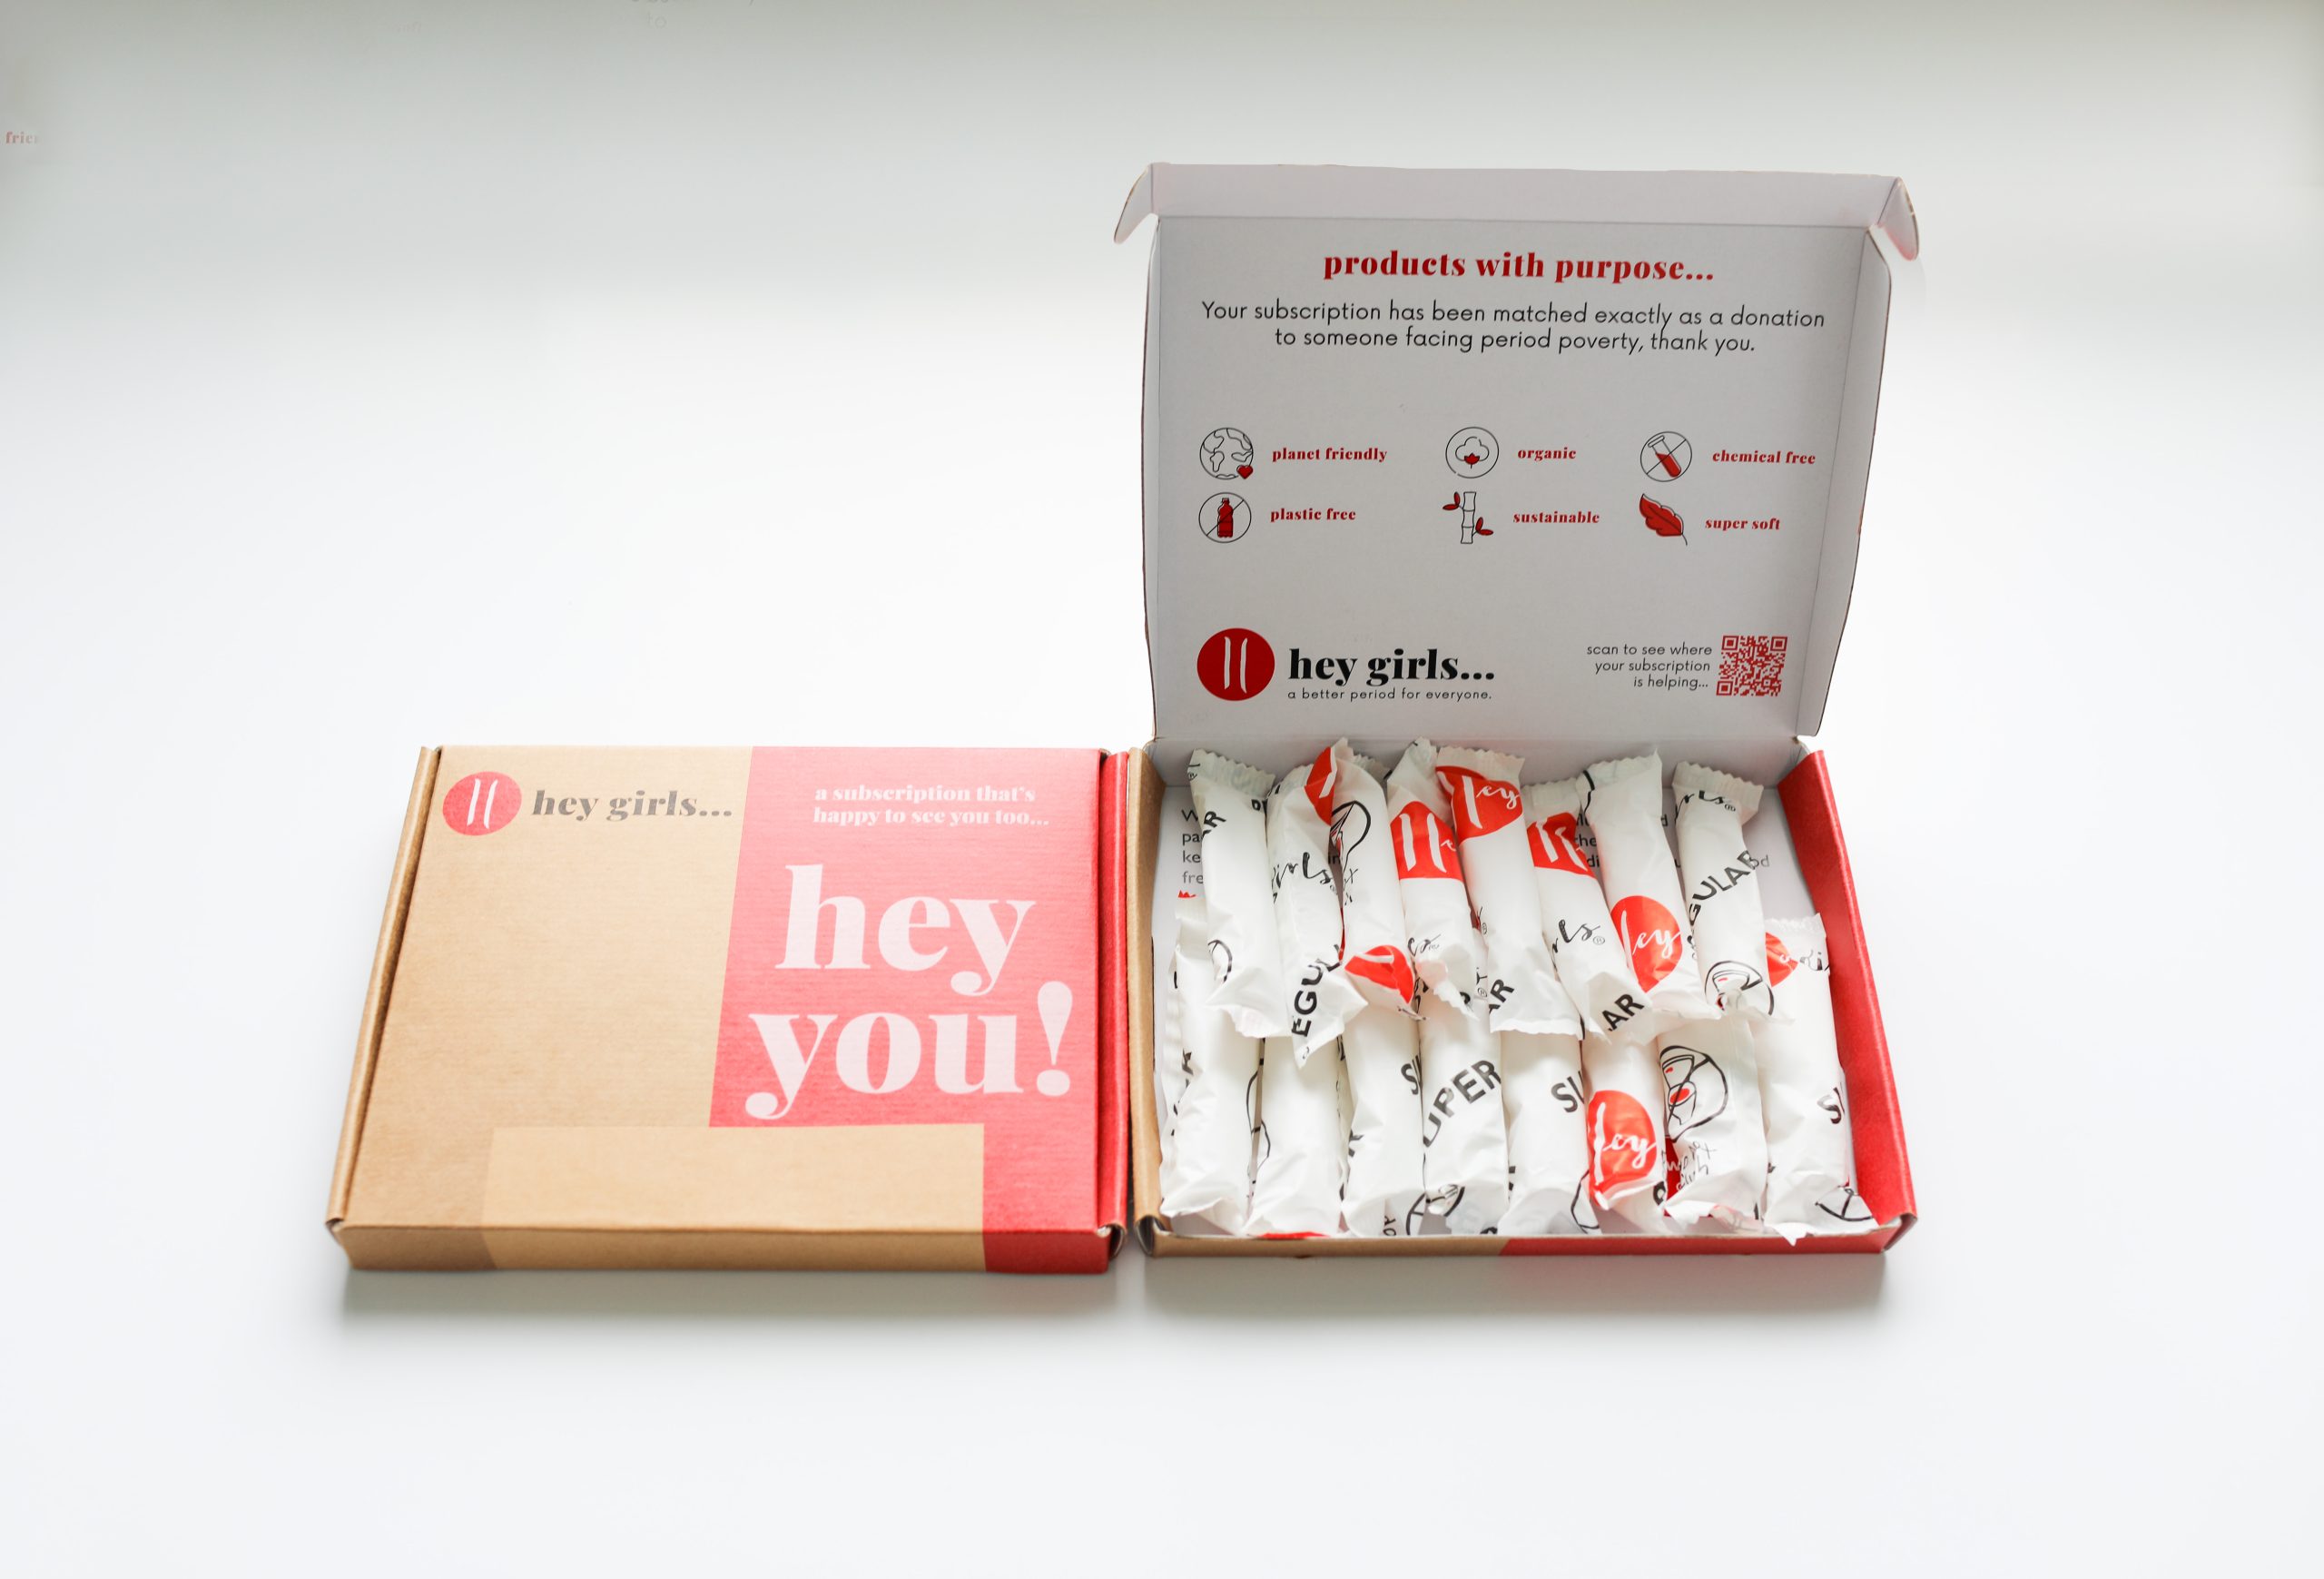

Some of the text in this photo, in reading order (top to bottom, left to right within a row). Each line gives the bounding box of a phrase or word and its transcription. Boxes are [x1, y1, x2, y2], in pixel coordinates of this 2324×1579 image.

[1324, 250, 1714, 284] products with purpose...
[1201, 297, 1825, 332] Your subscription has been matched exactly as a donation
[1275, 325, 1755, 357] to someone facing period poverty, thank you.
[1272, 447, 1386, 463] planet friendly
[1517, 447, 1577, 461] organic
[1712, 449, 1816, 464] chemical free
[1270, 508, 1356, 523] plastic free
[1513, 510, 1600, 524] sustainable
[1705, 518, 1780, 532] super soft
[1587, 642, 1713, 656] scan to see where
[1288, 647, 1495, 687] hey girls...
[1595, 658, 1710, 676] your subscription
[1633, 675, 1709, 692] is helping...
[1287, 687, 1492, 703] a better period for everyone.
[814, 784, 1035, 805] a subscription that's
[531, 789, 733, 822] hey girls...
[812, 806, 1049, 827] happy to see you too...
[774, 864, 1036, 996] hey
[745, 981, 1073, 1120] you!
